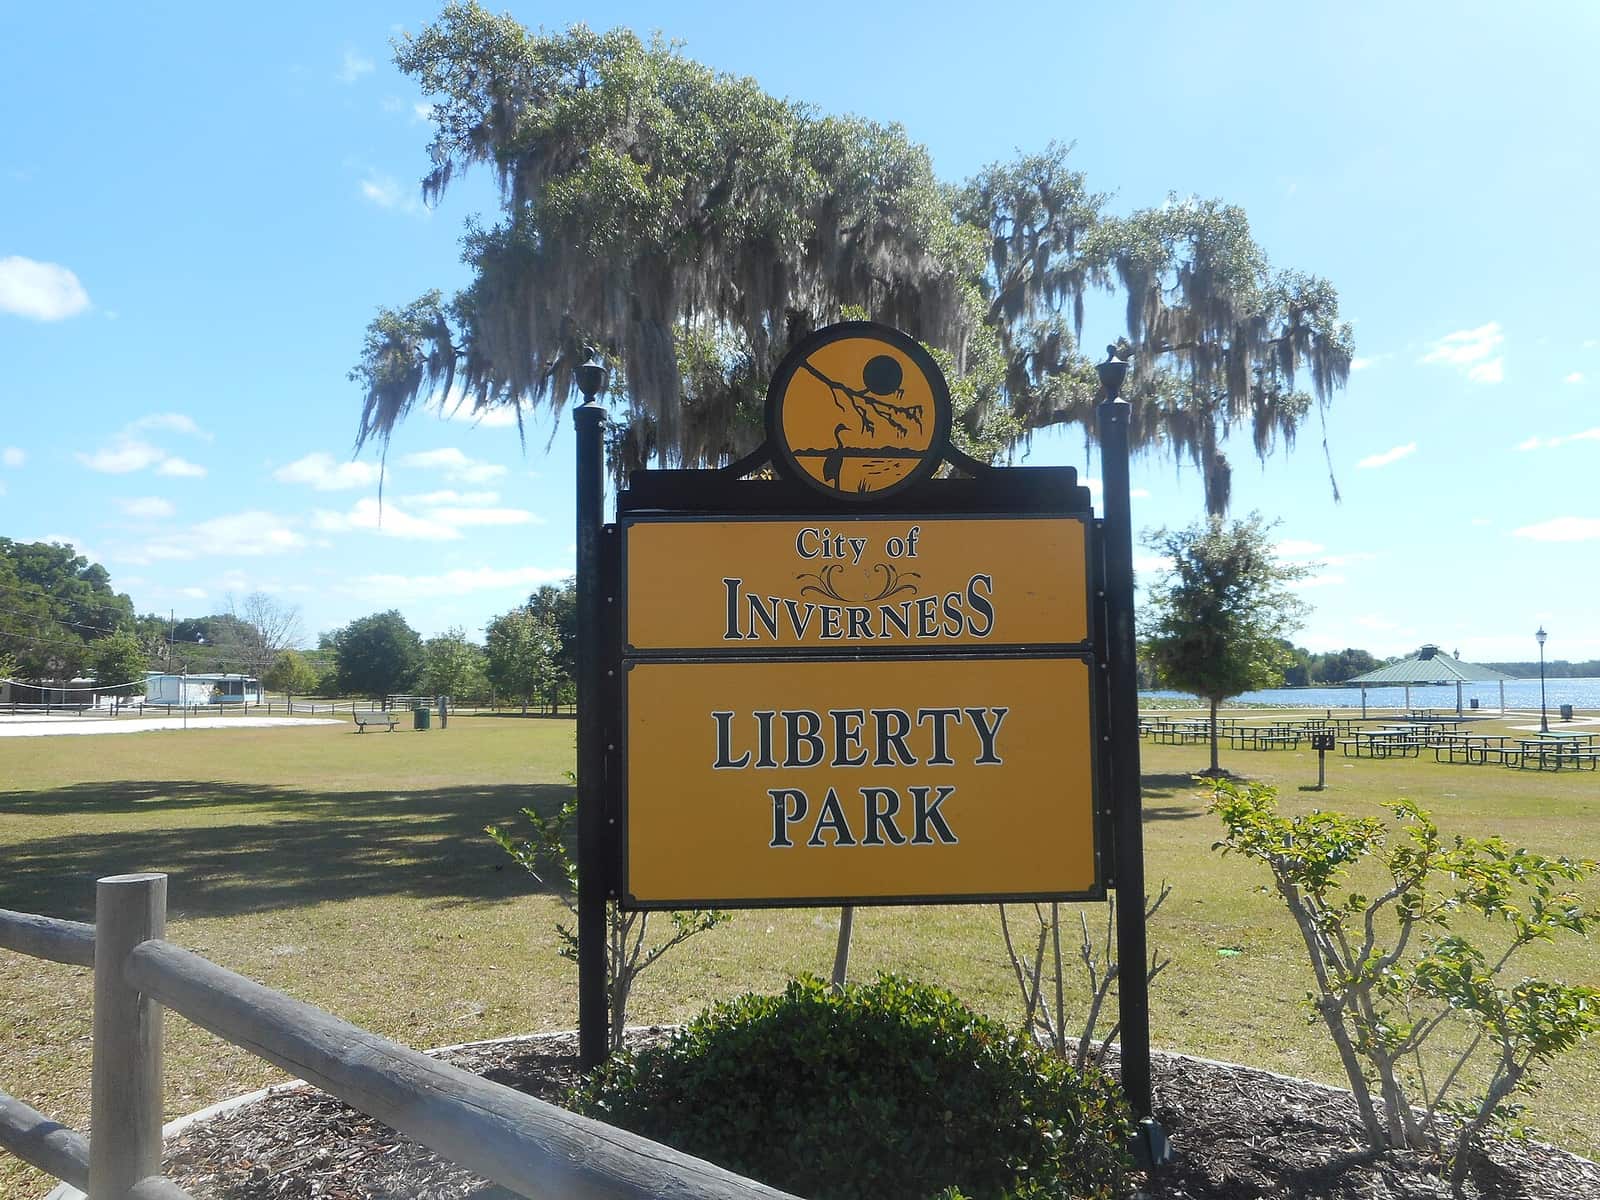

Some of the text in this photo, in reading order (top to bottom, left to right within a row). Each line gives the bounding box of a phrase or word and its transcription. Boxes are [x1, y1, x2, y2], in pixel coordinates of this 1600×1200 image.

[796, 526, 921, 565] City of
[722, 574, 995, 641] INVERNESS
[711, 706, 1009, 770] LIBERTY
[768, 786, 959, 848] PARK
